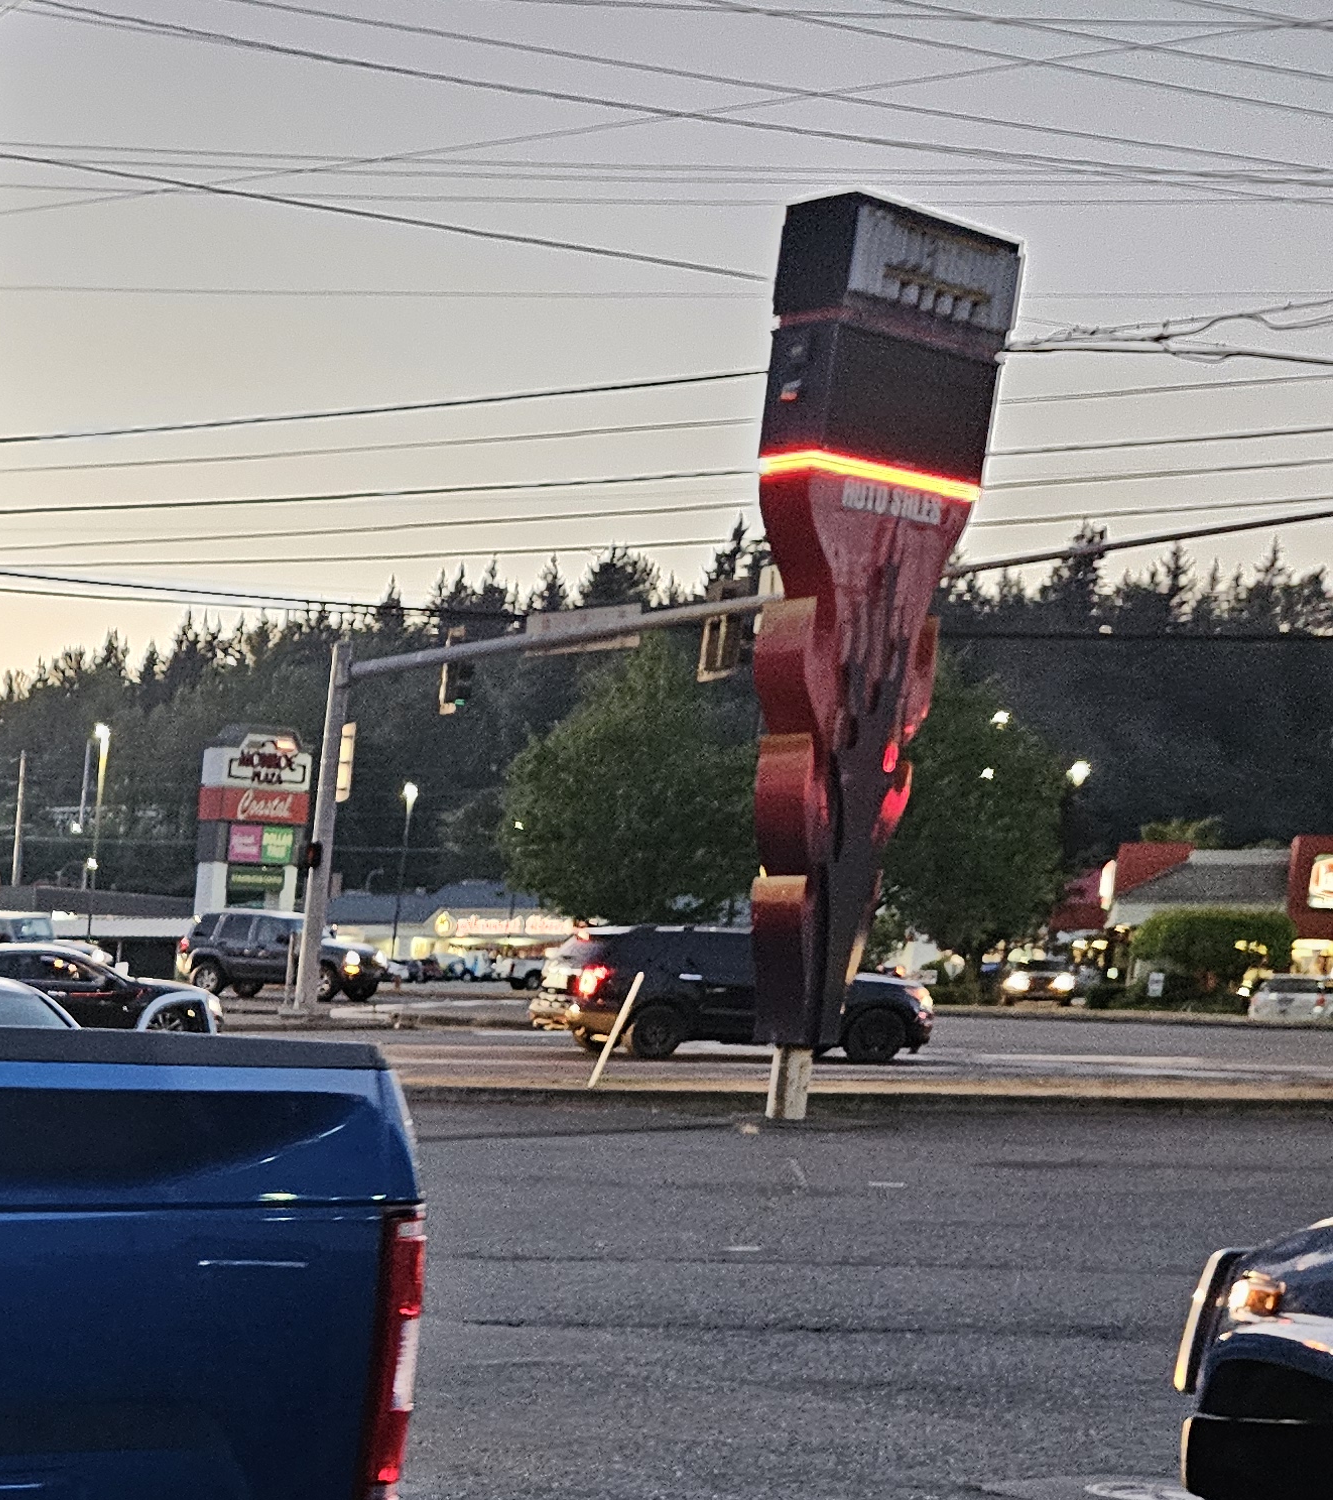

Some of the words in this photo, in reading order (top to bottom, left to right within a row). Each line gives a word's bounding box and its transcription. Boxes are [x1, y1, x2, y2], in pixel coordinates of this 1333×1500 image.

[842, 479, 889, 514] AUTO
[890, 486, 941, 525] SALES
[237, 788, 293, 820] Coastal
